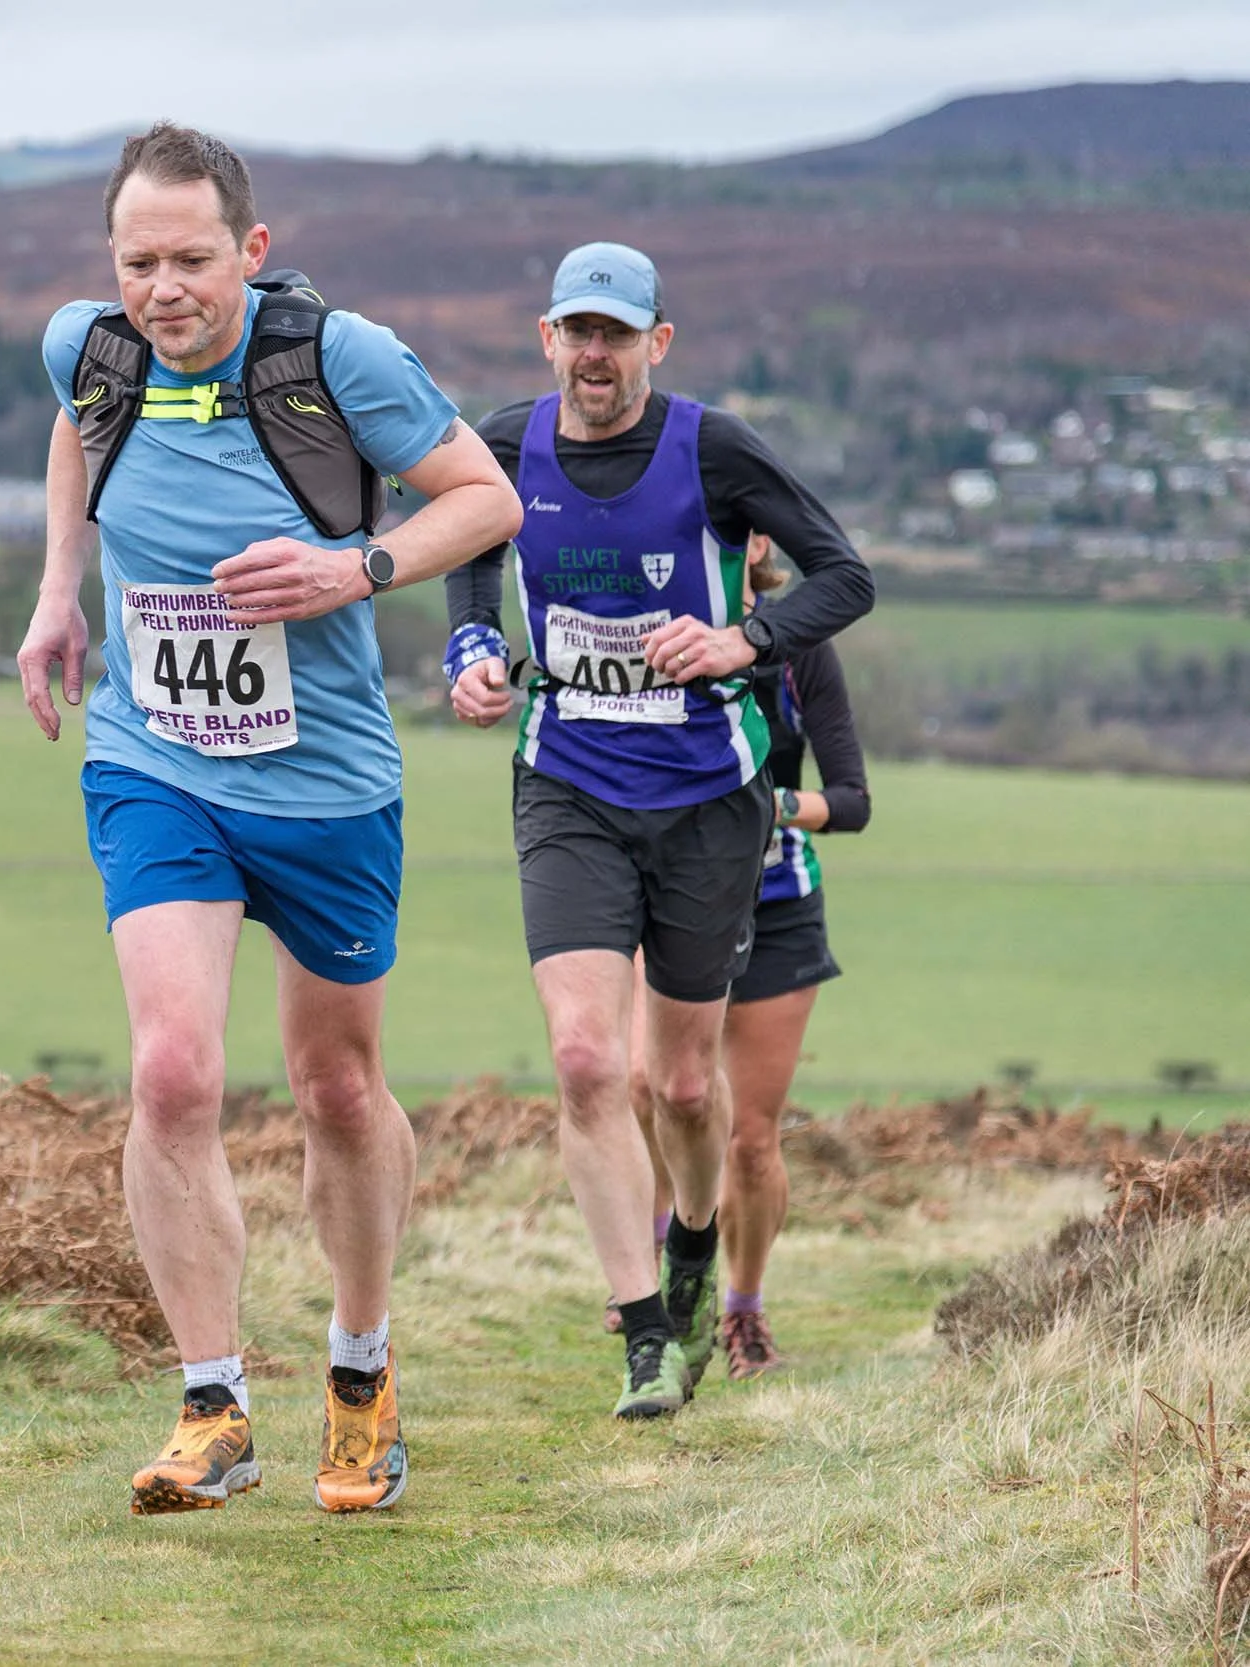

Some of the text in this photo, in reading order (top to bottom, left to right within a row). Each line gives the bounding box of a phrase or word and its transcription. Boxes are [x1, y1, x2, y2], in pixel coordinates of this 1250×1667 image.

[558, 547, 621, 569] ELVET
[543, 573, 646, 594] STRIDERS
[140, 612, 174, 631] FELL
[564, 632, 590, 650] FELL
[153, 638, 266, 706] 446
[590, 699, 645, 713] SPORTS
[143, 706, 292, 731] PETE BLAND
[178, 731, 251, 746] SPORTS
